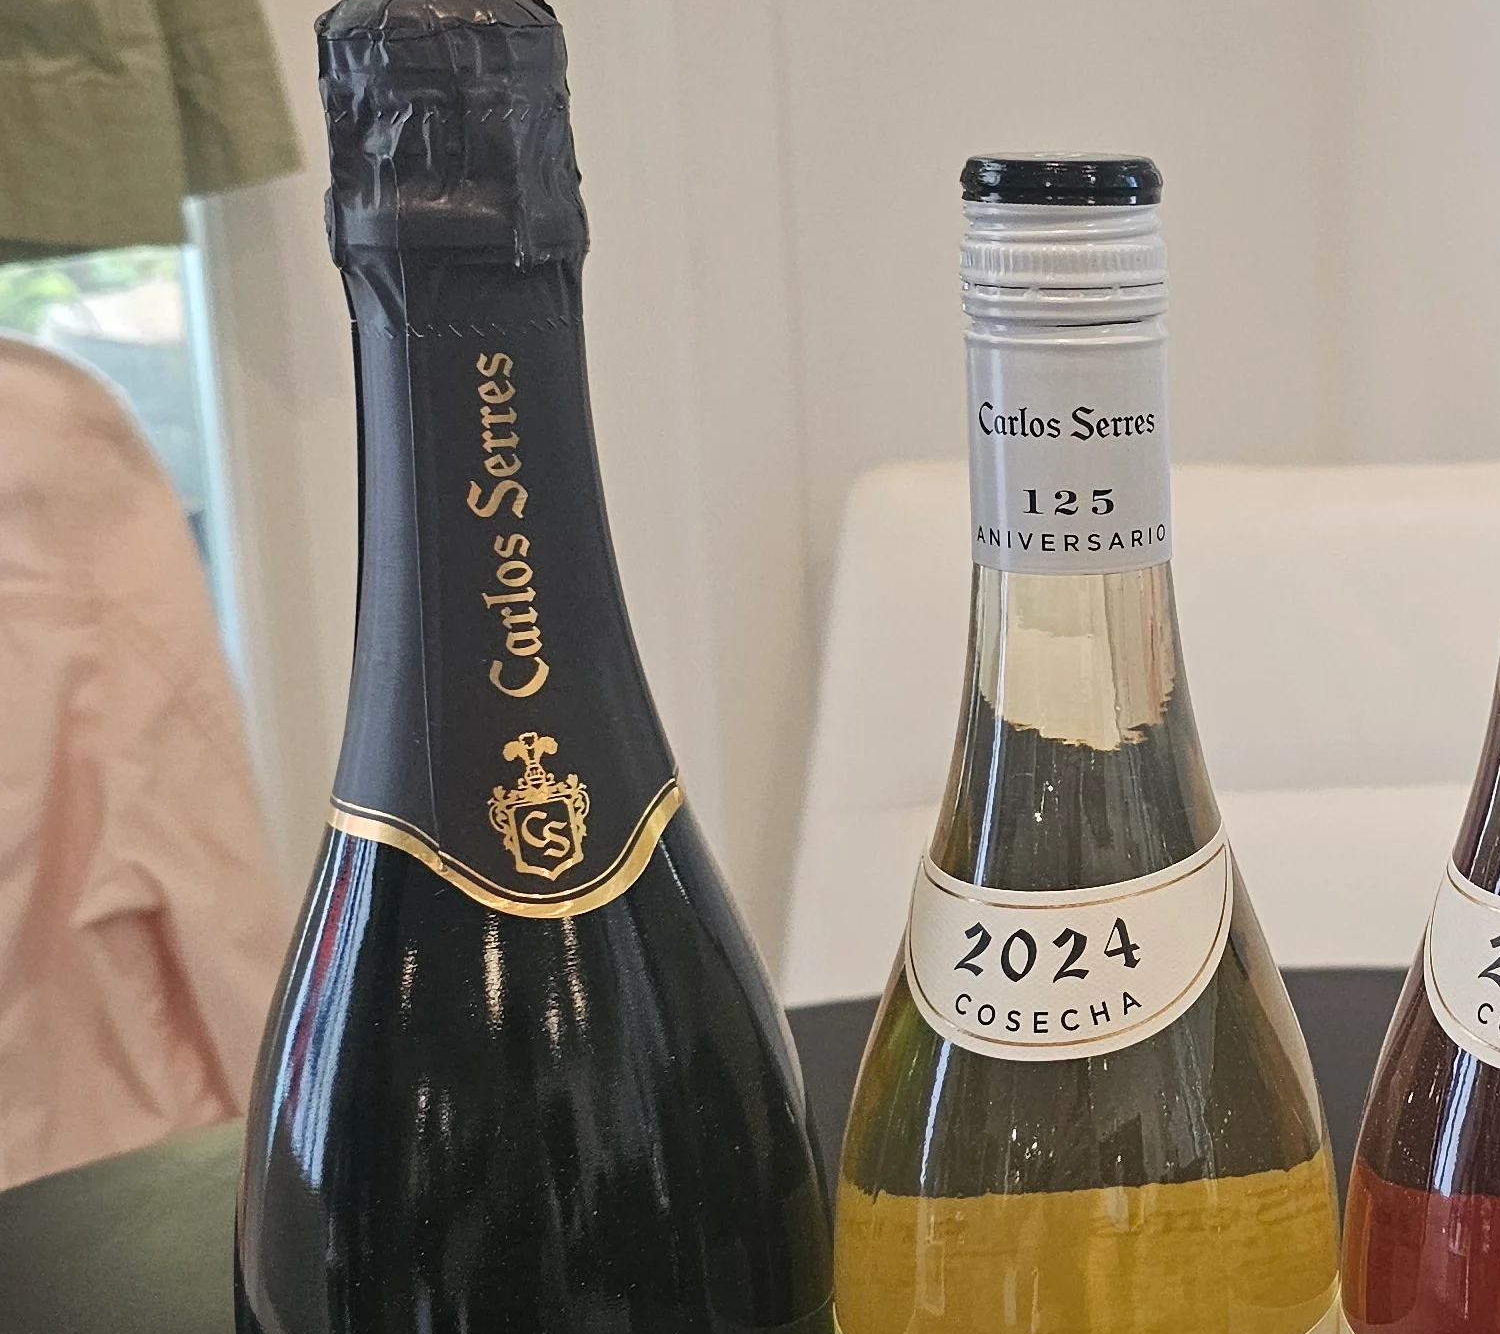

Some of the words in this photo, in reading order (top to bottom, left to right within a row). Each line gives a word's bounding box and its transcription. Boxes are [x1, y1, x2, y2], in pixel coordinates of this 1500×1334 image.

[468, 351, 530, 519] Serres
[978, 400, 1061, 440] Carlos
[1070, 405, 1155, 442] Serres
[1021, 487, 1115, 516] 125
[976, 522, 1166, 553] ANIVERSARIO
[481, 532, 550, 699] Carlos
[953, 917, 1141, 984] 2024
[954, 990, 1143, 1034] COSECHA
